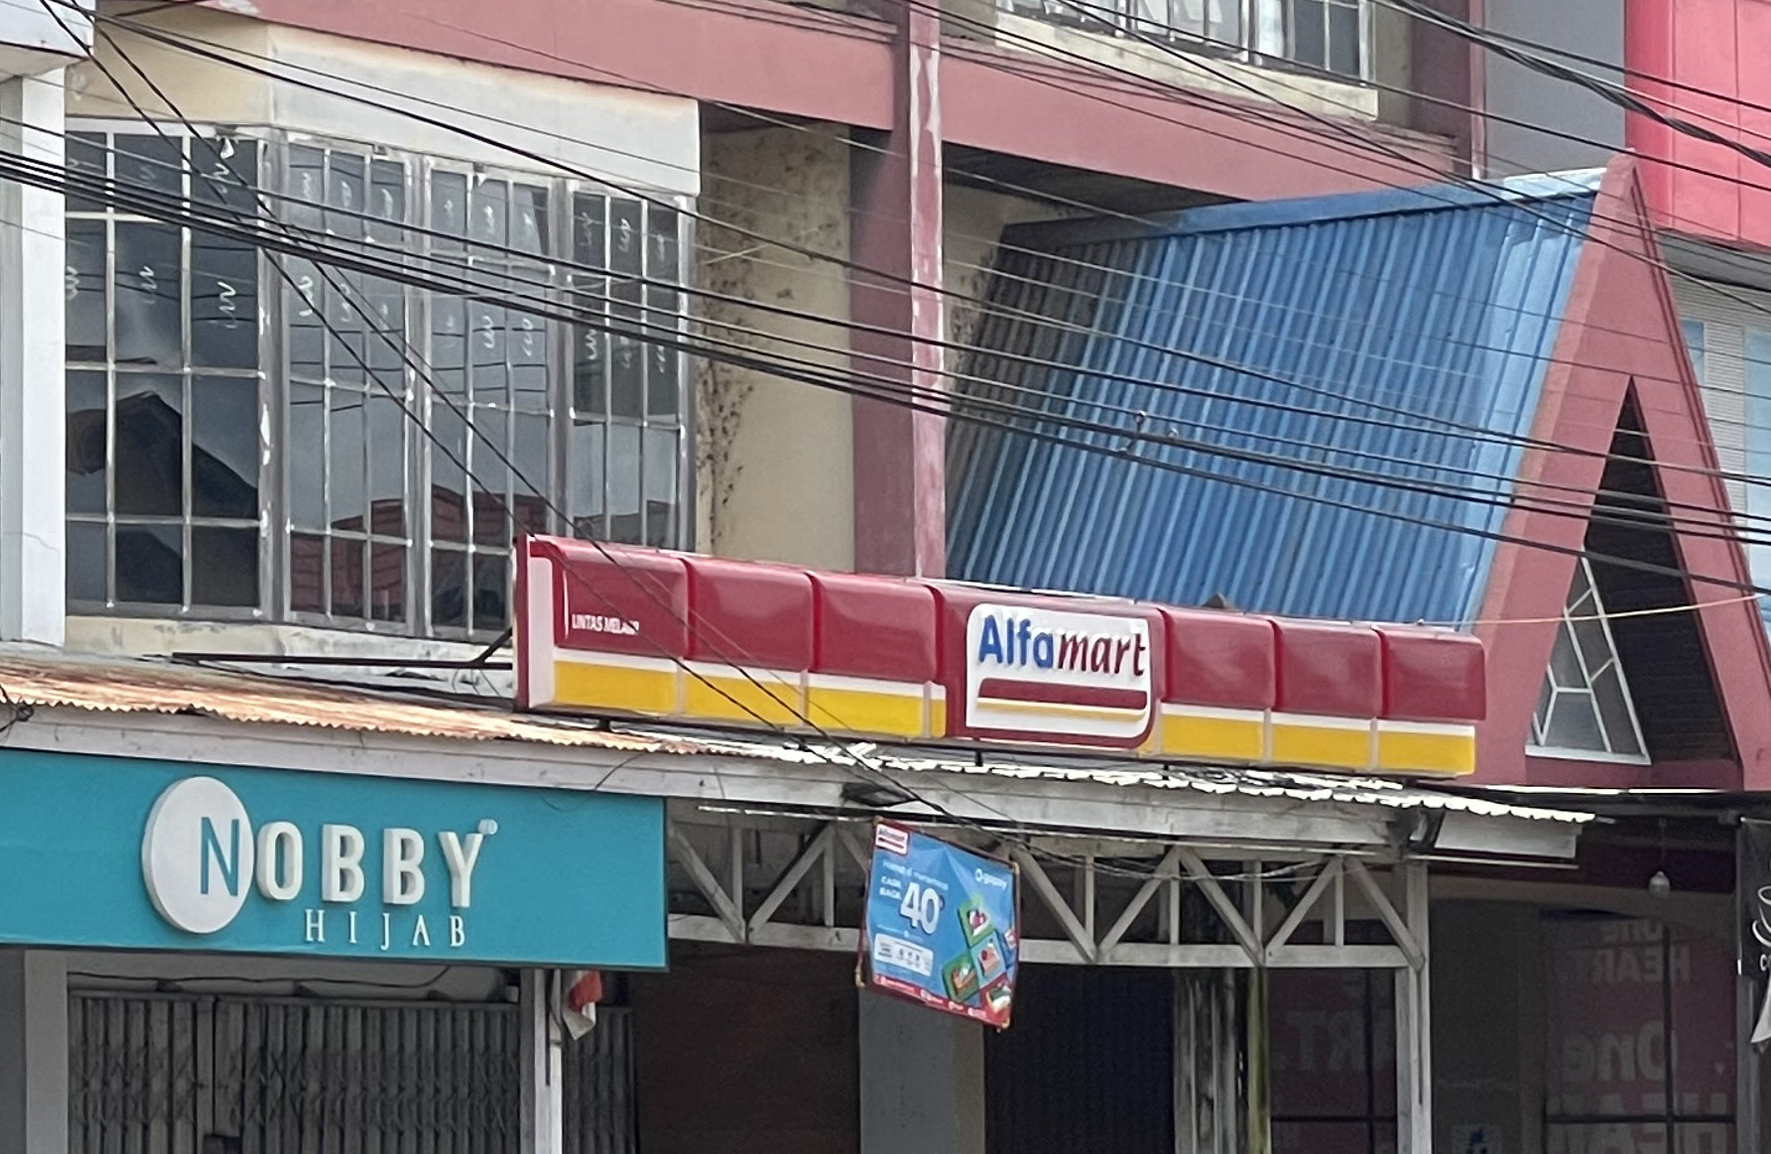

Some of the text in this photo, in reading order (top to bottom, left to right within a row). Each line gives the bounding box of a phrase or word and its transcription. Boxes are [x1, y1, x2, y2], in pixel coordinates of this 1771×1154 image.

[979, 614, 1146, 677] Alfamart
[195, 812, 485, 910] NOBBY
[304, 908, 465, 951] HIJAB
